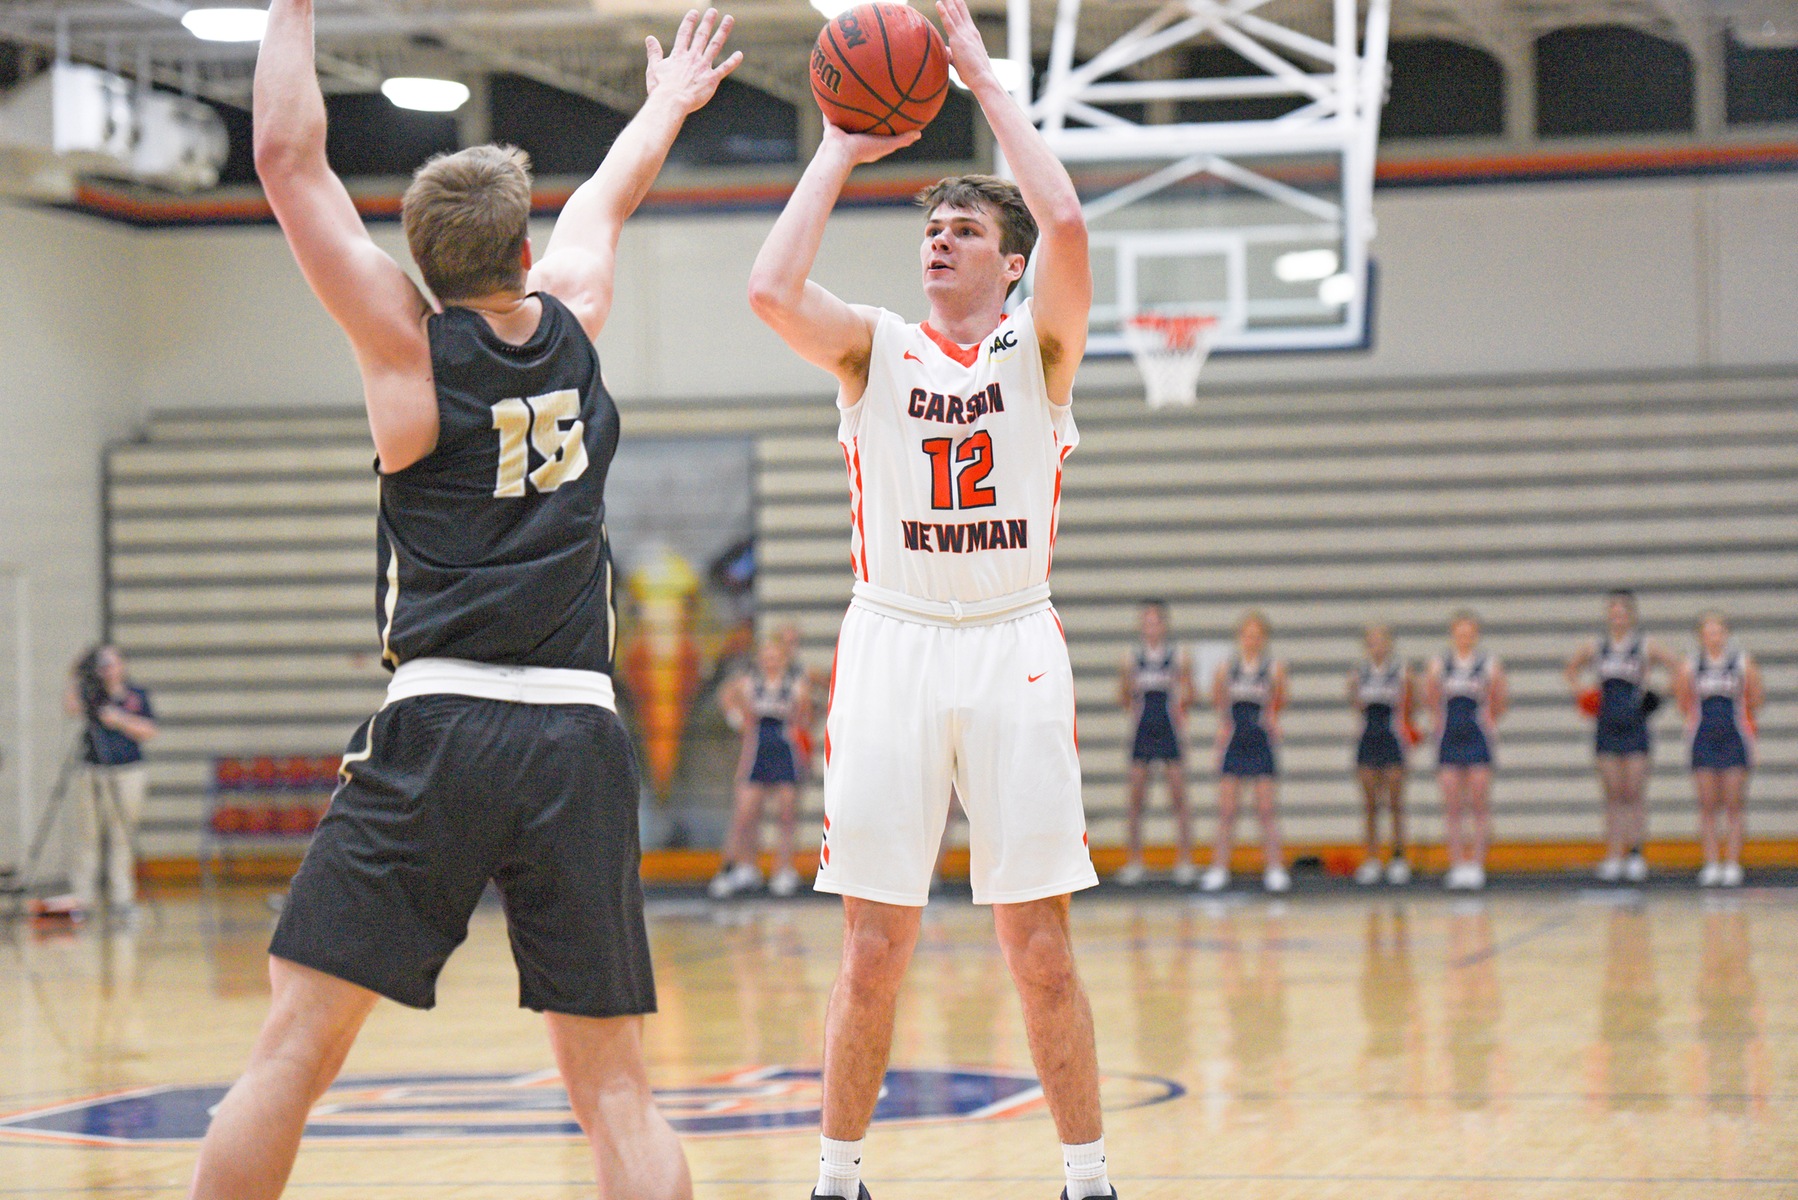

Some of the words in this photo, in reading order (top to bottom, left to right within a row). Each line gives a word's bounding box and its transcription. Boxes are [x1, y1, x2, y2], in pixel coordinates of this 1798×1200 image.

[908, 382, 1005, 424] CARSON
[490, 388, 589, 498] 15
[922, 429, 997, 511] 12
[901, 519, 1028, 553] NEWMAN
